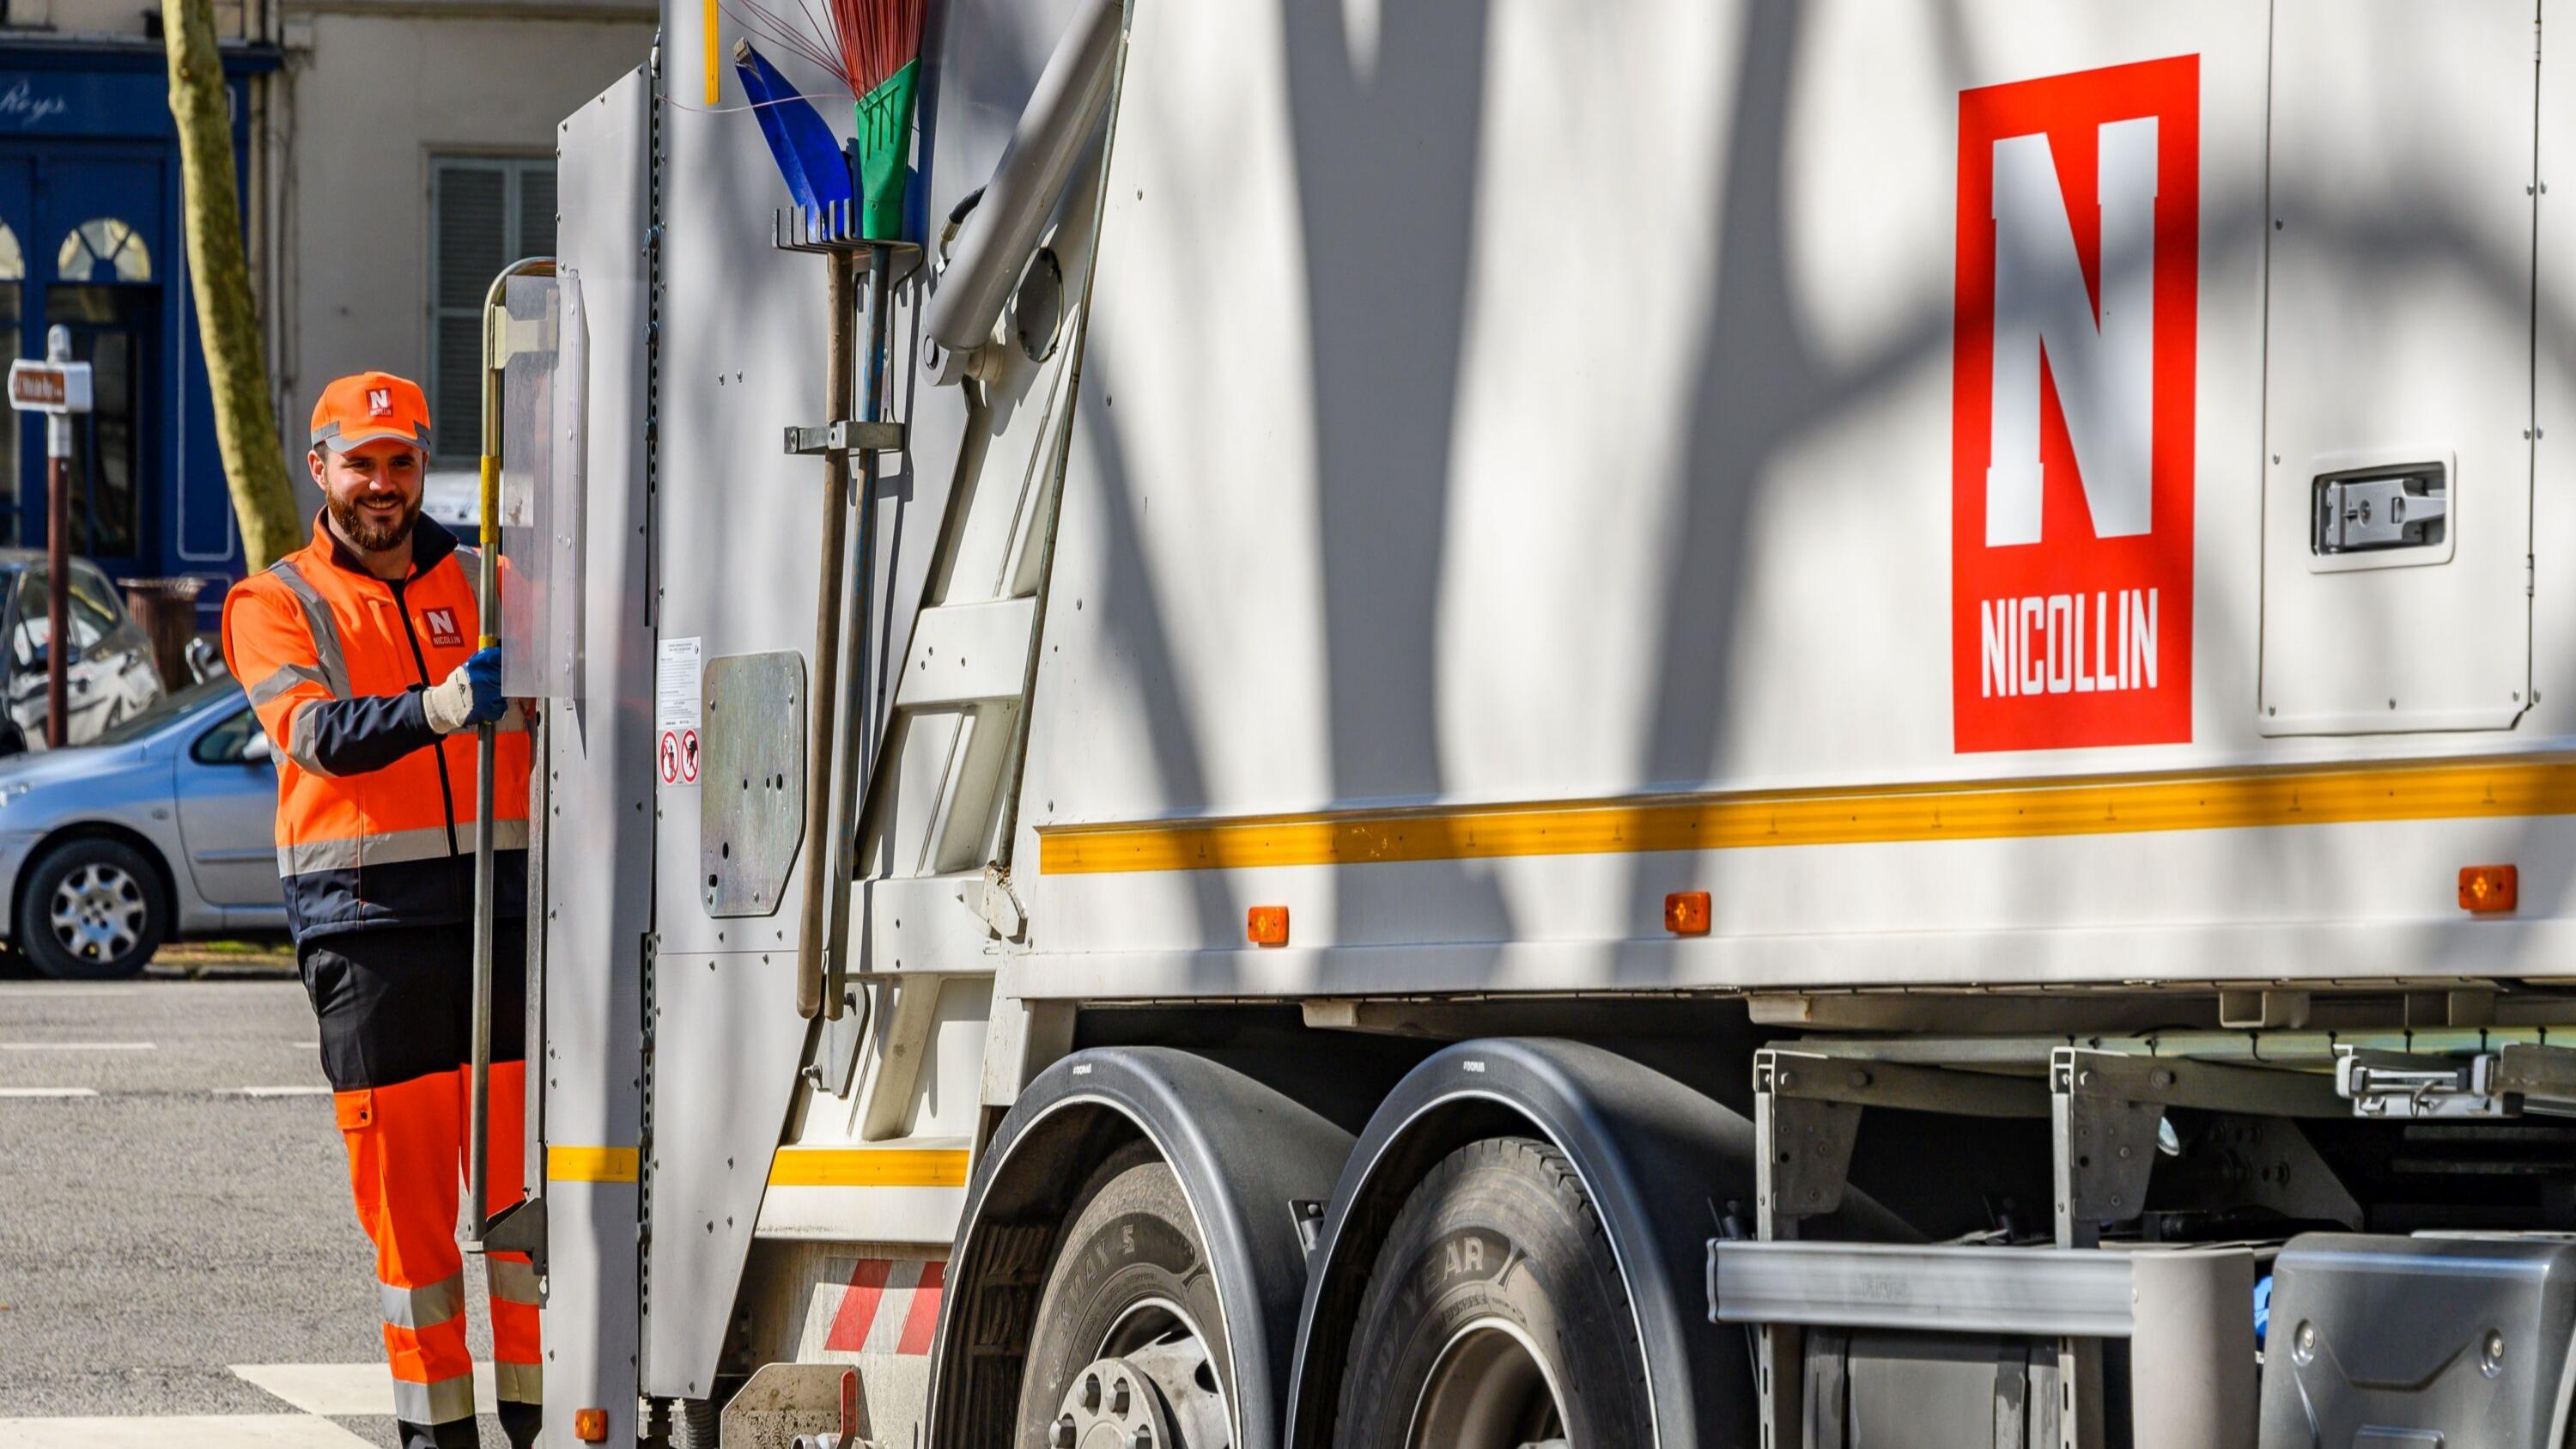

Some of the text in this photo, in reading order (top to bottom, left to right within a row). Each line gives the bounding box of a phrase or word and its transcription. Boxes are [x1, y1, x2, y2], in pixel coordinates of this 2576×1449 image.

[1985, 116, 2159, 547] N
[370, 389, 388, 409] N
[427, 610, 454, 635] N
[433, 636, 461, 645] NICOLLIN
[1980, 588, 2159, 698] NICOLLIN
